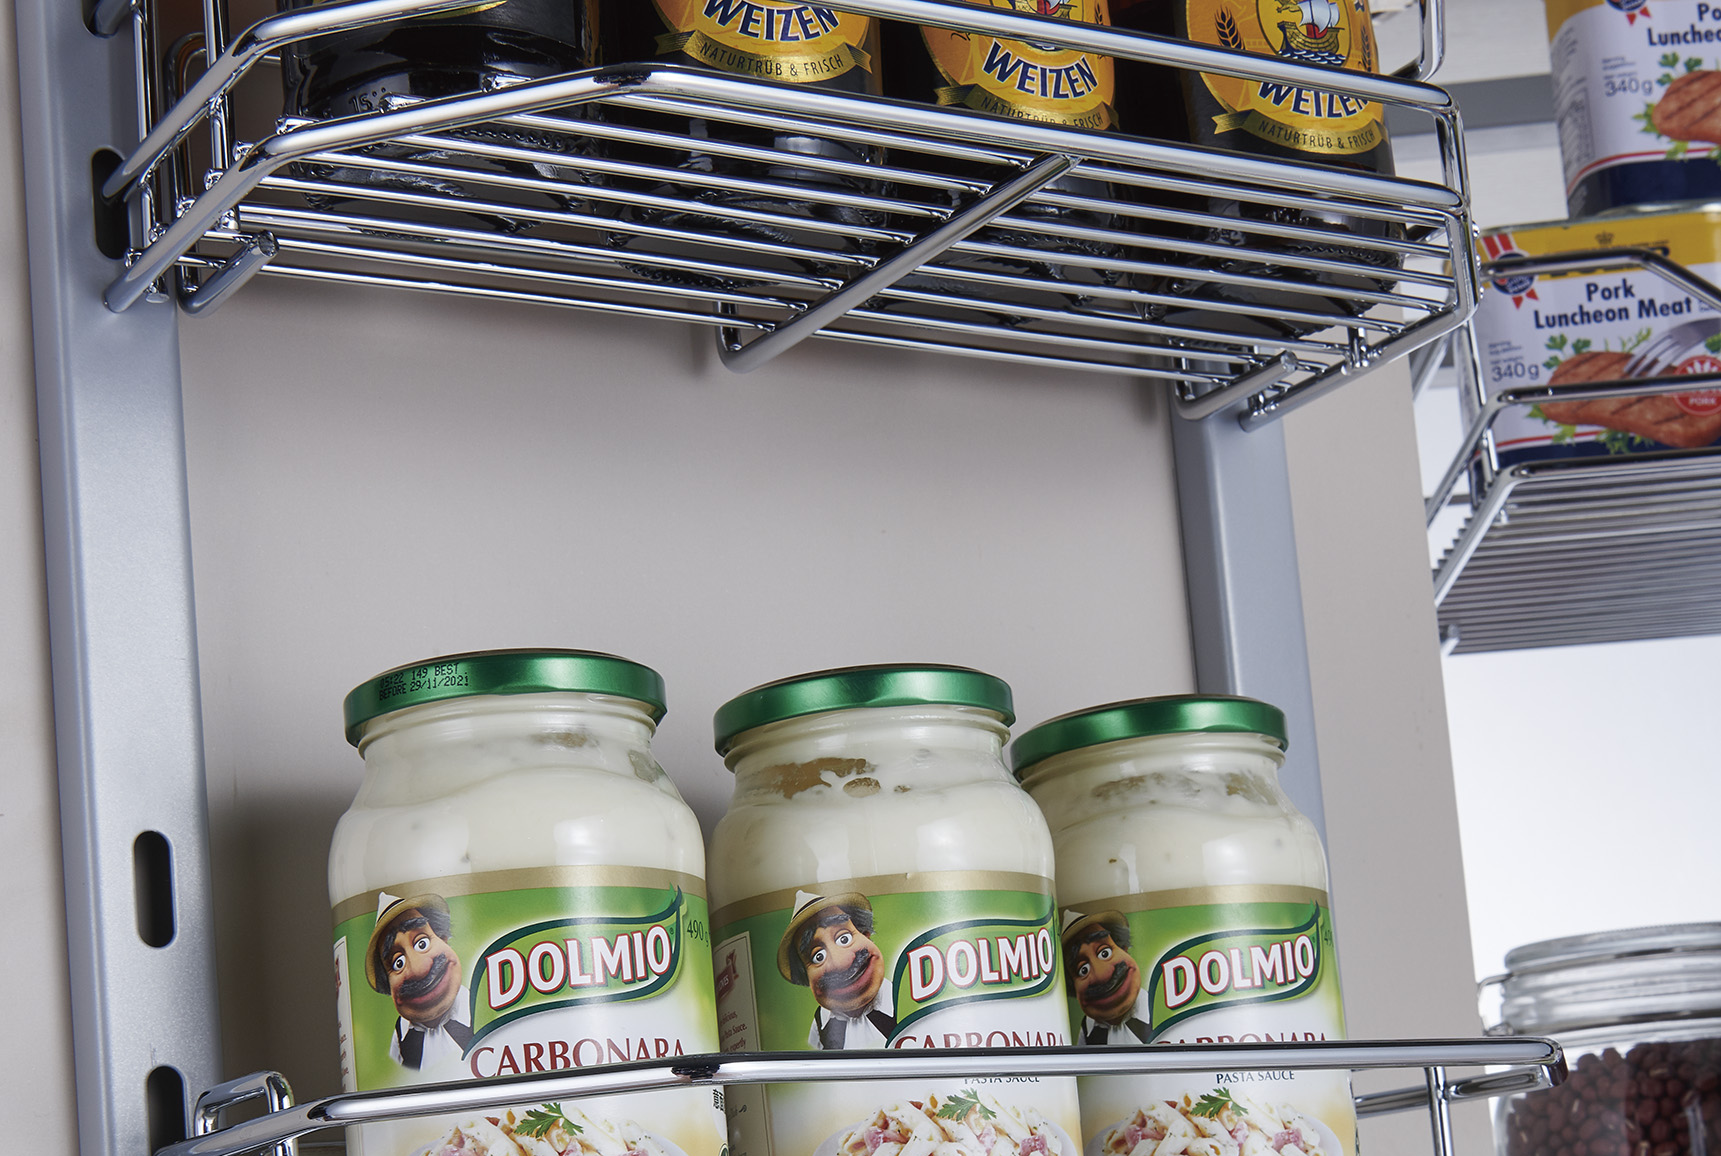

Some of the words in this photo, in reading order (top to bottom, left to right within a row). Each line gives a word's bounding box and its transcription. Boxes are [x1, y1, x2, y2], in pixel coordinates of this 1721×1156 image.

[702, 0, 840, 42] WEIZEN
[700, 42, 783, 76] NATURTRÜB
[790, 64, 799, 77] &
[803, 53, 844, 76] FRISCH
[982, 38, 1099, 100] WEIZEN
[1604, 79, 1639, 98] 340
[1641, 80, 1653, 97] g
[1258, 120, 1333, 149] NATURTRÜB
[1338, 138, 1345, 149] &
[1348, 128, 1376, 148] FRISCH
[1585, 278, 1636, 302] Pork
[1533, 304, 1630, 330] Luncheon
[1638, 296, 1692, 319] Meat
[1491, 362, 1526, 382] 340
[1527, 364, 1540, 381] g
[412, 668, 428, 680] 149
[434, 663, 460, 677] BEST
[379, 683, 407, 701] BEFORE
[686, 919, 704, 941] 490
[485, 924, 673, 1011] DOLMIO
[906, 926, 1054, 1003] DOLMIO
[1161, 933, 1316, 1010] DOLMIO
[1216, 1071, 1254, 1084] PASTA
[1258, 1070, 1295, 1082] SAUCE
